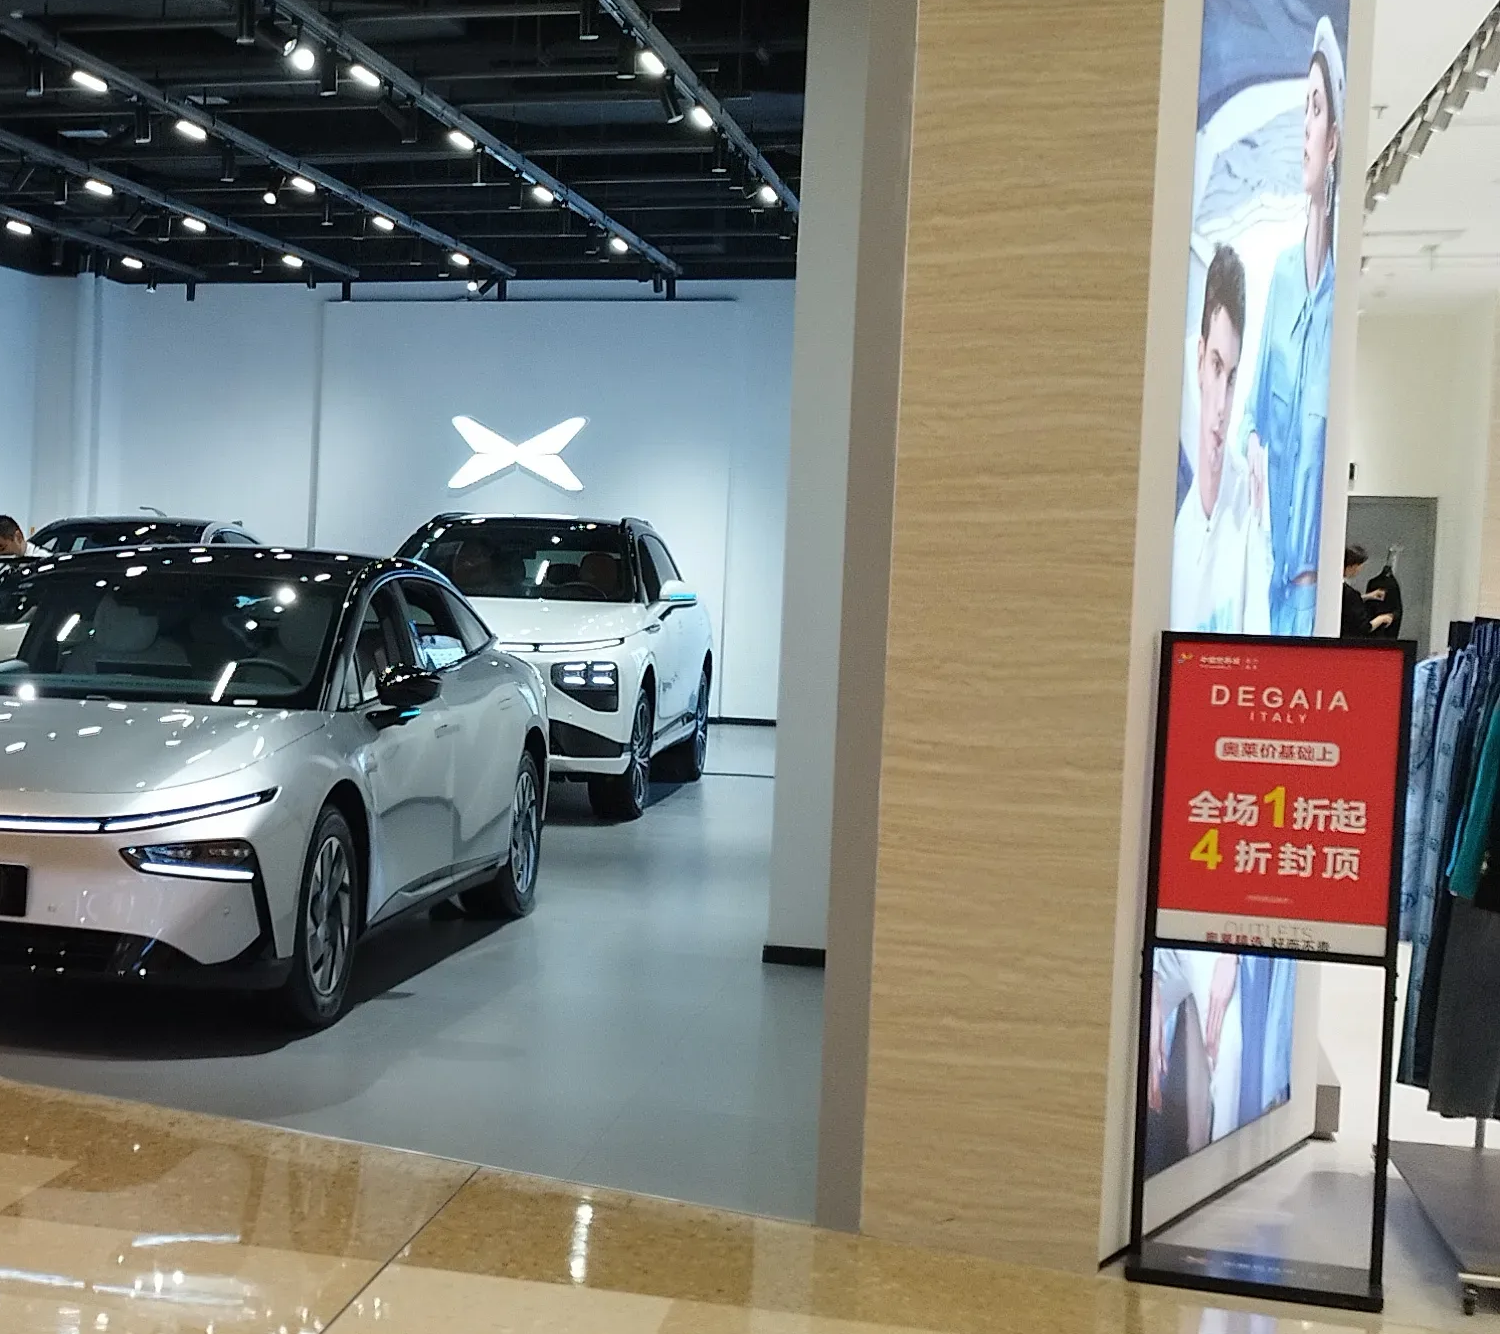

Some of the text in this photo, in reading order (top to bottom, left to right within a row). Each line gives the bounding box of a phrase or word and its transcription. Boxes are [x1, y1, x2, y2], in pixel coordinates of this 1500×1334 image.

[1210, 683, 1350, 712] DEGAIA
[1249, 711, 1308, 725] ITALY
[1221, 741, 1335, 763] 奥莱价基础上
[1187, 785, 1368, 835] 全场1折起
[1189, 827, 1362, 882] 4折封顶
